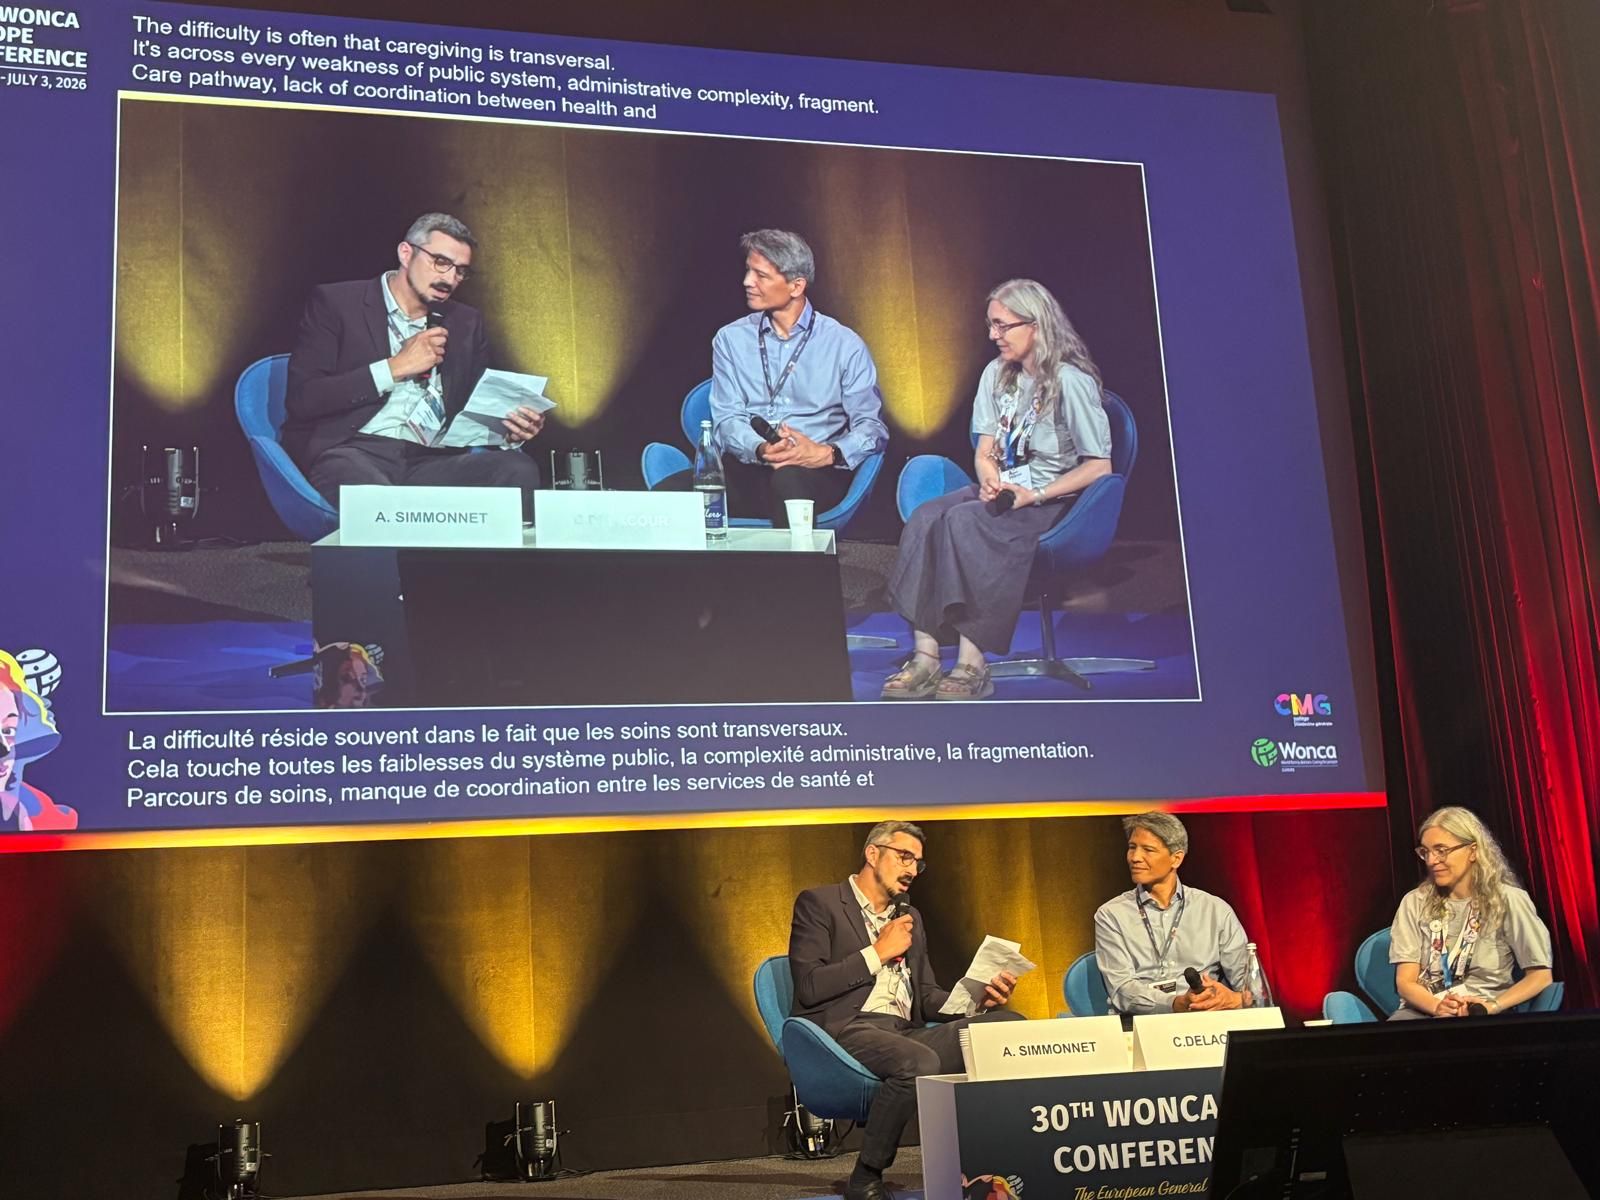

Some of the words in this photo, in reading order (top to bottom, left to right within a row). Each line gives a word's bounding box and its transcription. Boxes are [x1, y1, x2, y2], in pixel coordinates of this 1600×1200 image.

[0, 6, 80, 28] WONCA
[133, 16, 172, 34] The
[179, 20, 261, 45] difficulty
[267, 27, 282, 43] is
[289, 30, 337, 48] often
[344, 34, 380, 51] that
[386, 41, 482, 63] caregiving
[489, 45, 504, 61] is
[510, 48, 614, 70] transversal.
[41, 75, 52, 89] 3,
[56, 77, 87, 90] 2026
[134, 39, 161, 57] It's
[168, 46, 234, 62] across
[241, 52, 296, 71] every
[301, 56, 399, 75] weakness
[405, 62, 424, 77] of
[430, 64, 485, 83] public
[491, 71, 561, 91] system,
[568, 75, 692, 99] administrative
[697, 89, 793, 110] complexity,
[798, 93, 878, 113] fragment.
[132, 64, 181, 83] Care
[190, 70, 276, 94] pathway,
[284, 75, 323, 94] lack
[329, 80, 348, 95] of
[354, 85, 470, 104] coordination
[478, 90, 555, 111] between
[562, 97, 617, 116] health
[624, 104, 656, 119] and
[375, 511, 390, 523] A.
[395, 511, 488, 524] SIMMONNET
[1274, 693, 1332, 716] CMG
[129, 731, 155, 750] La
[164, 729, 254, 749] difficulté
[262, 728, 328, 747] réside
[335, 727, 418, 745] souvent
[425, 725, 475, 743] dans
[482, 725, 499, 742] le
[506, 724, 537, 742] fait
[543, 728, 579, 745] que
[587, 723, 614, 740] les
[621, 722, 670, 739] soins
[677, 722, 718, 738] sont
[723, 722, 847, 737] transversaux.
[128, 759, 178, 779] Cela
[187, 758, 260, 777] touche
[269, 758, 334, 775] toutes
[342, 755, 372, 773] les
[379, 753, 484, 772] faiblesses
[490, 752, 515, 769] du
[522, 750, 605, 772] système
[612, 748, 674, 770] public,
[681, 748, 697, 764] la
[704, 746, 804, 767] complexité
[810, 744, 941, 762] administrative,
[947, 743, 962, 759] la
[968, 742, 1094, 763] fragmentation.
[1278, 741, 1337, 760] Wonca
[128, 788, 227, 807] Parcours
[235, 785, 262, 804] de
[270, 784, 332, 805] soins,
[342, 785, 426, 804] manque
[434, 780, 459, 797] de
[466, 777, 589, 796] coordination
[597, 776, 646, 792] entre
[653, 774, 680, 791] les
[687, 772, 765, 790] services
[771, 771, 794, 788] de
[800, 770, 850, 787] santé
[857, 770, 874, 786] et
[1003, 1046, 1016, 1057] A.
[1019, 1041, 1096, 1056] SIMMONNET
[1103, 1094, 1219, 1127] WONCA
[1074, 1186, 1096, 1200] The
[1097, 1185, 1155, 1200] European
[1158, 1177, 1209, 1196] General
